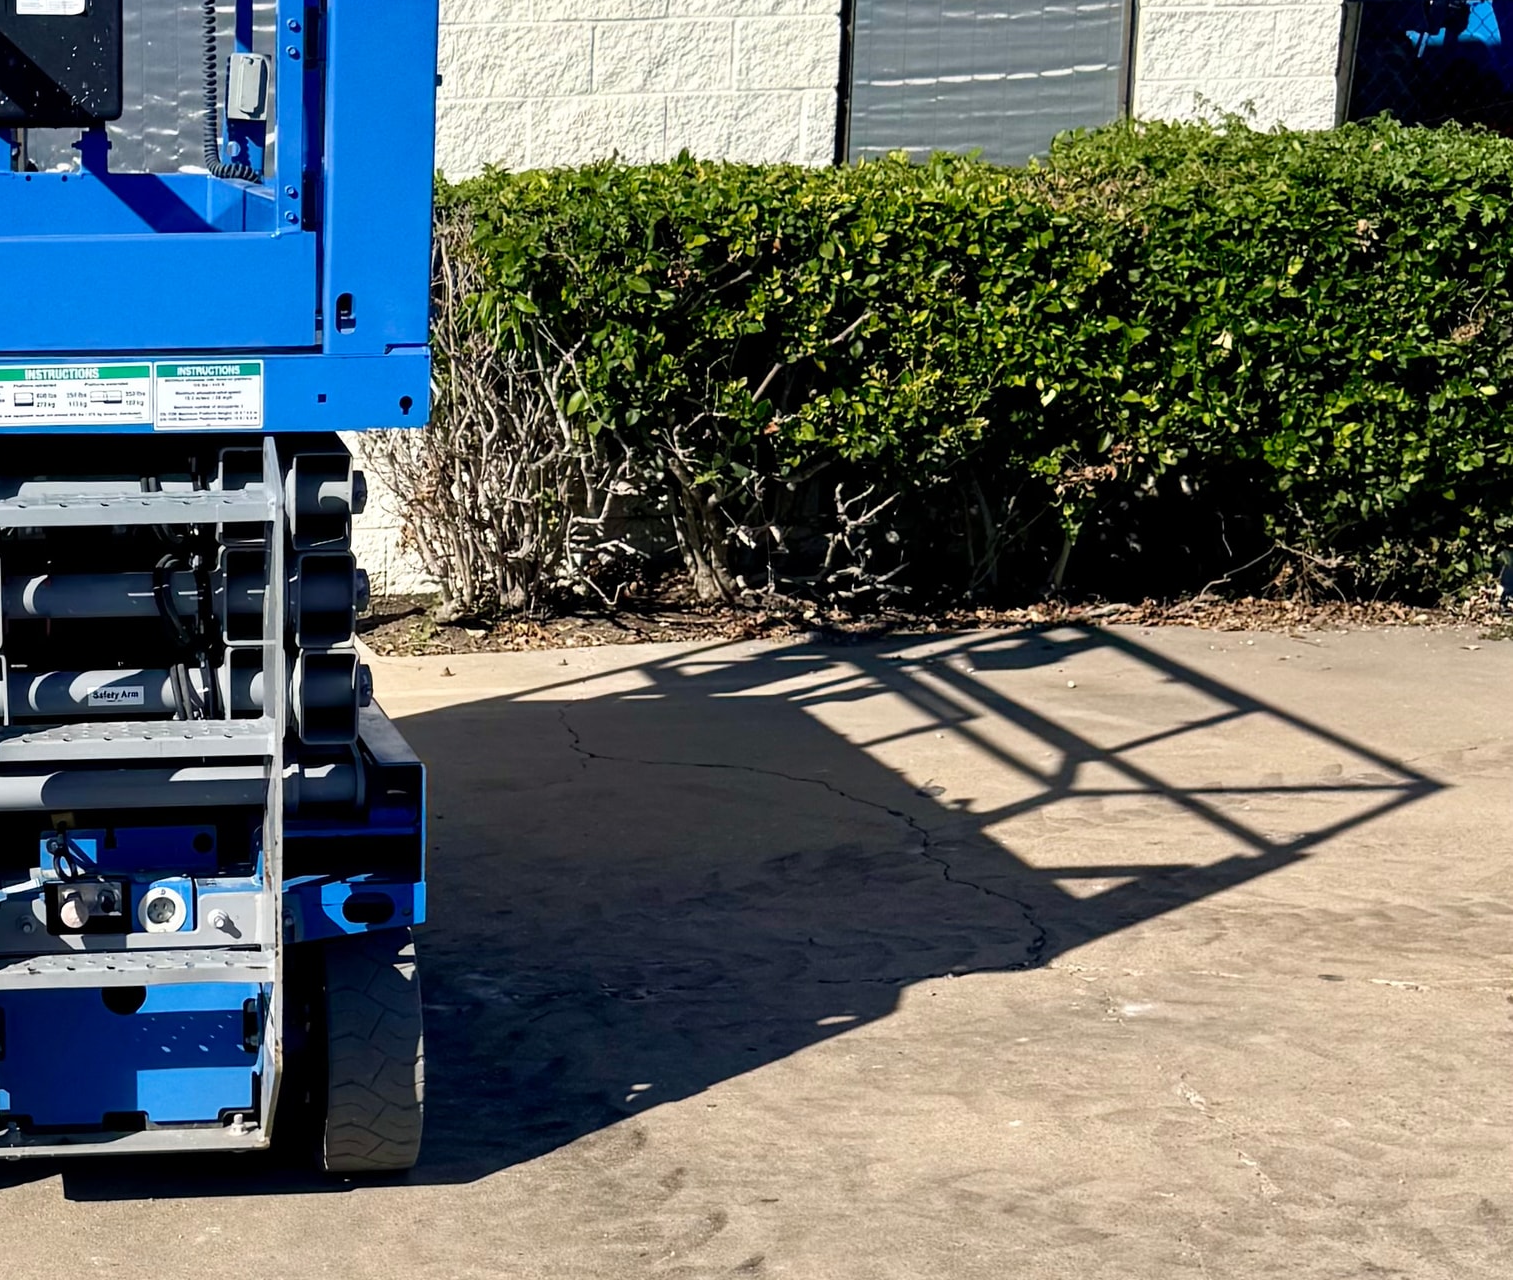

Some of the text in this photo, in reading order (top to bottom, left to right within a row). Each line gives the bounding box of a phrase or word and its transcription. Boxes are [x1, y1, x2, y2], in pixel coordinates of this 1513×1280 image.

[25, 367, 100, 380] INSTRUCTIONS
[177, 365, 240, 376] INSTRUCTIONS
[92, 690, 139, 700] Safety Arm
